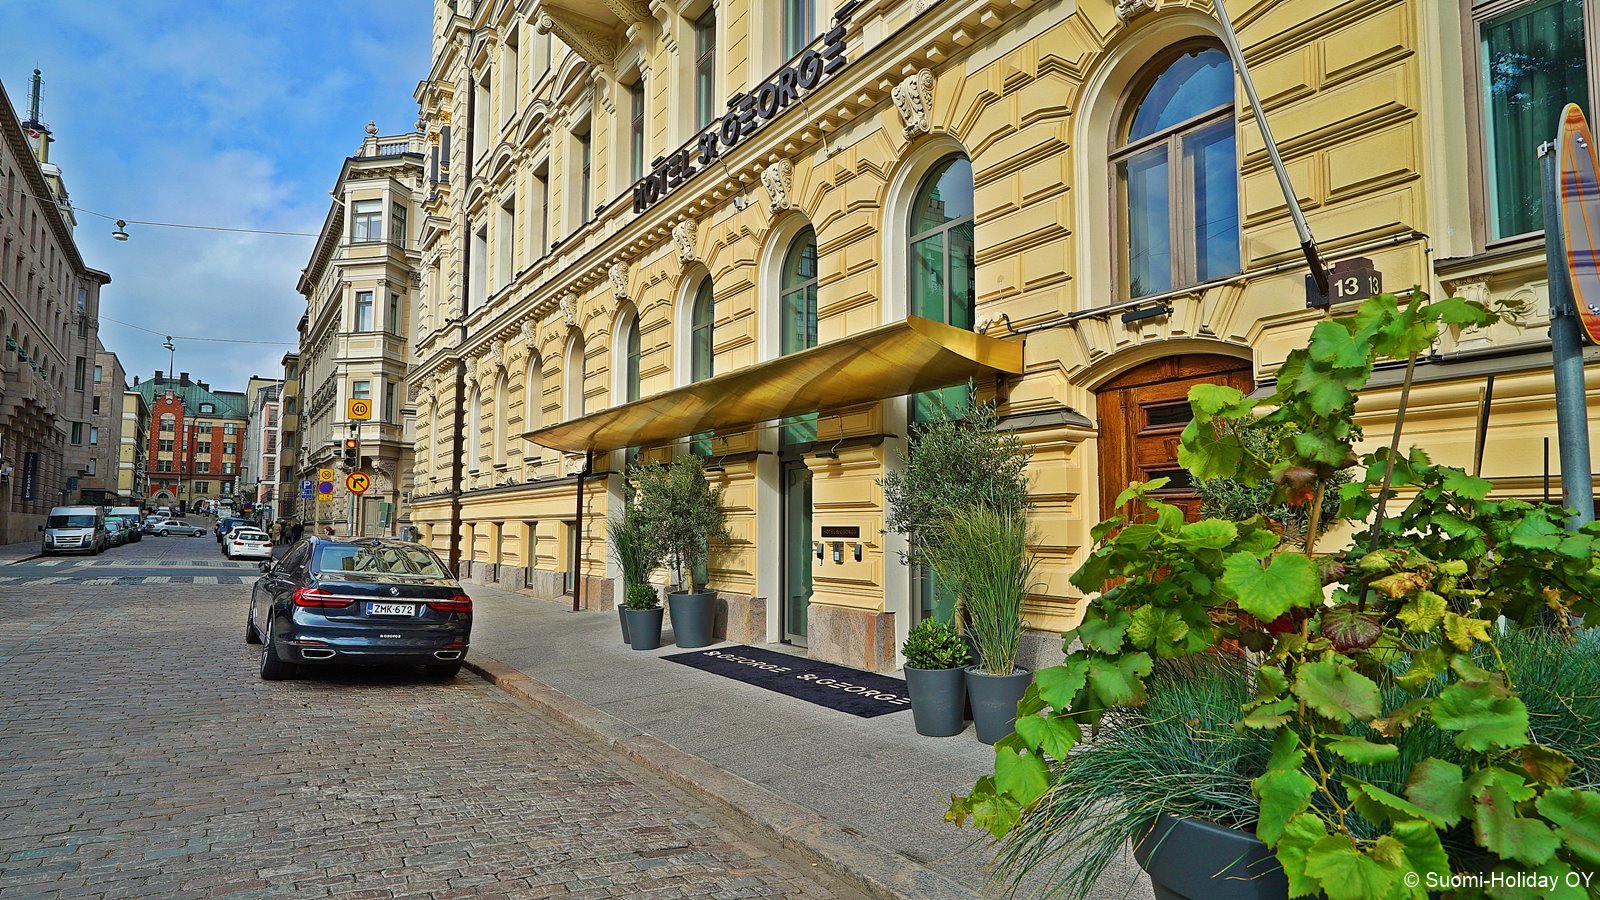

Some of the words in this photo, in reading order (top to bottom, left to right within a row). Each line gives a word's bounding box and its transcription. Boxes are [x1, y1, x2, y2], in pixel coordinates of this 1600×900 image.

[633, 149, 696, 214] HOTEL
[698, 132, 719, 165] St
[720, 26, 847, 147] GEORGE
[1334, 276, 1359, 297] 13
[1368, 275, 1379, 295] 13
[355, 405, 365, 413] 40
[303, 481, 311, 489] P
[717, 653, 792, 673] GEORGE
[815, 678, 911, 704] GEORGE
